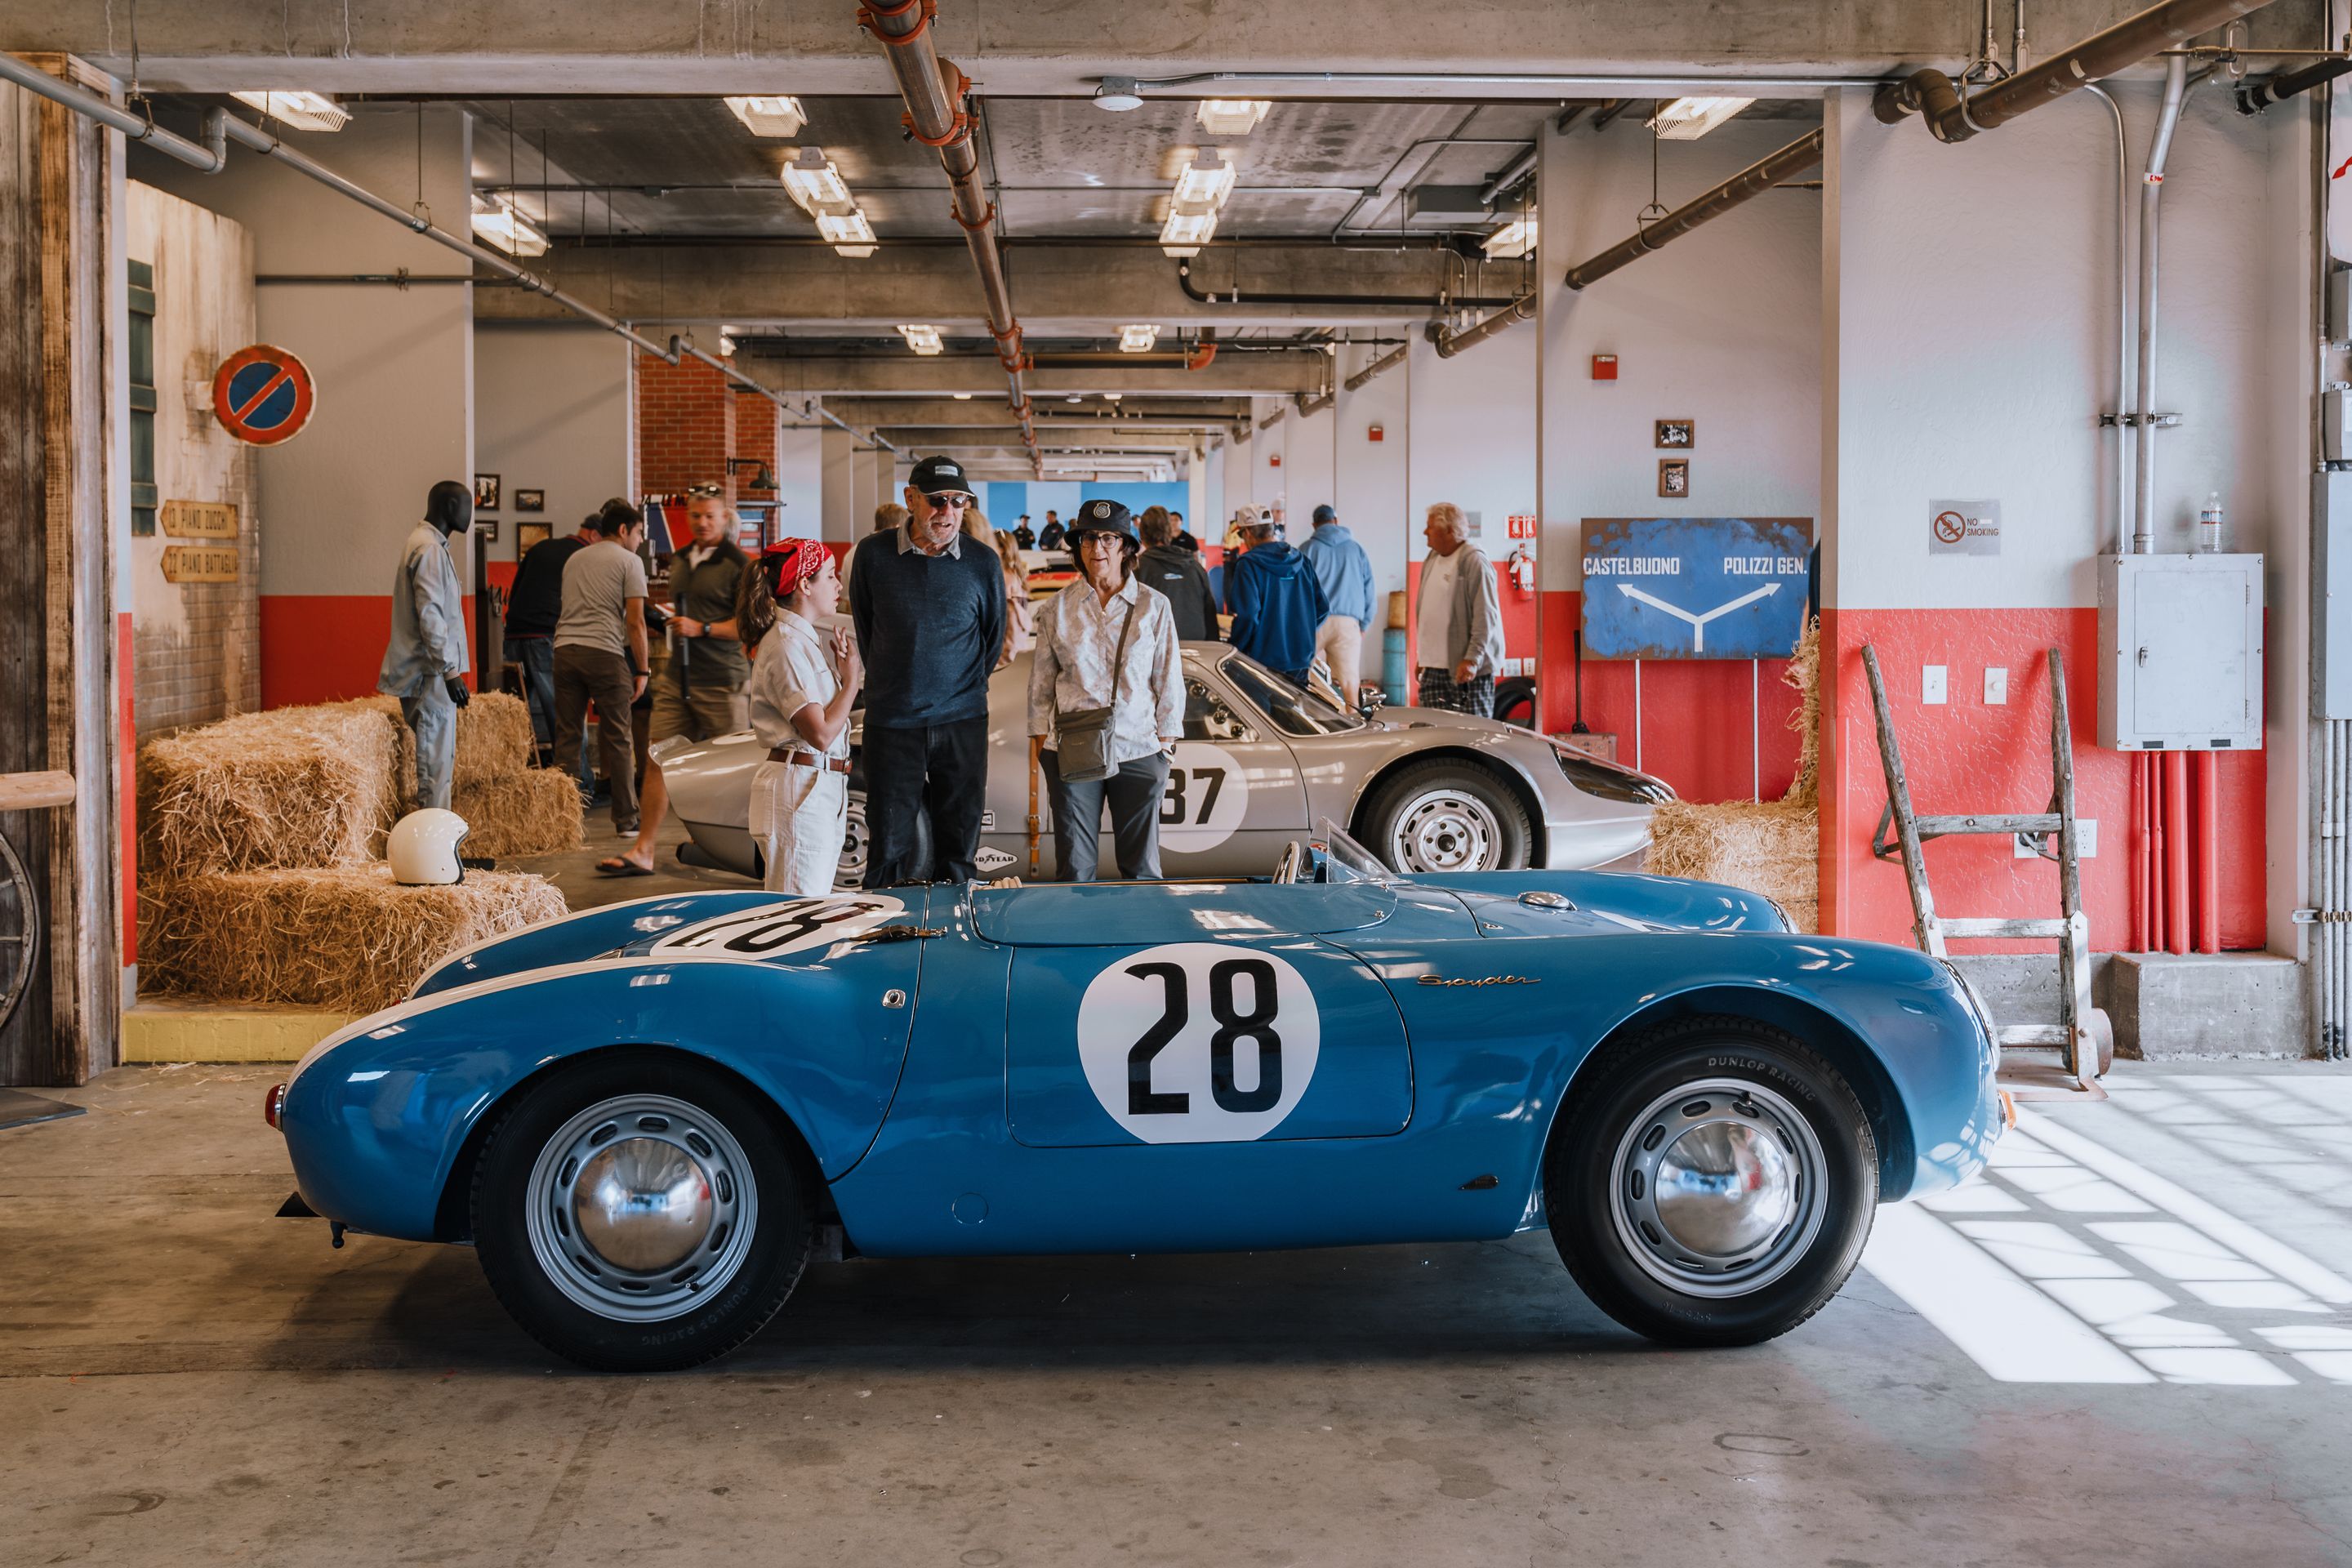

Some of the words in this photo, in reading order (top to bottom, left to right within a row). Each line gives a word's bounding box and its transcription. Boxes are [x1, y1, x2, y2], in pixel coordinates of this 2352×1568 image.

[181, 508, 201, 530] PIANO
[1967, 517, 1979, 527] NO
[1967, 528, 1999, 537] SMOKING
[181, 553, 201, 574] PIANO
[205, 553, 238, 574] BATTAGLIA
[1583, 557, 1680, 576] CASTELBUONO
[1723, 557, 1773, 575] POLIZZI
[1777, 557, 1807, 575] GEN.
[664, 899, 884, 953] 28
[1417, 974, 1541, 988] Spyder
[1124, 959, 1283, 1116] 28
[1708, 1057, 1766, 1071] DUNLOP
[1768, 1067, 1816, 1101] RACING
